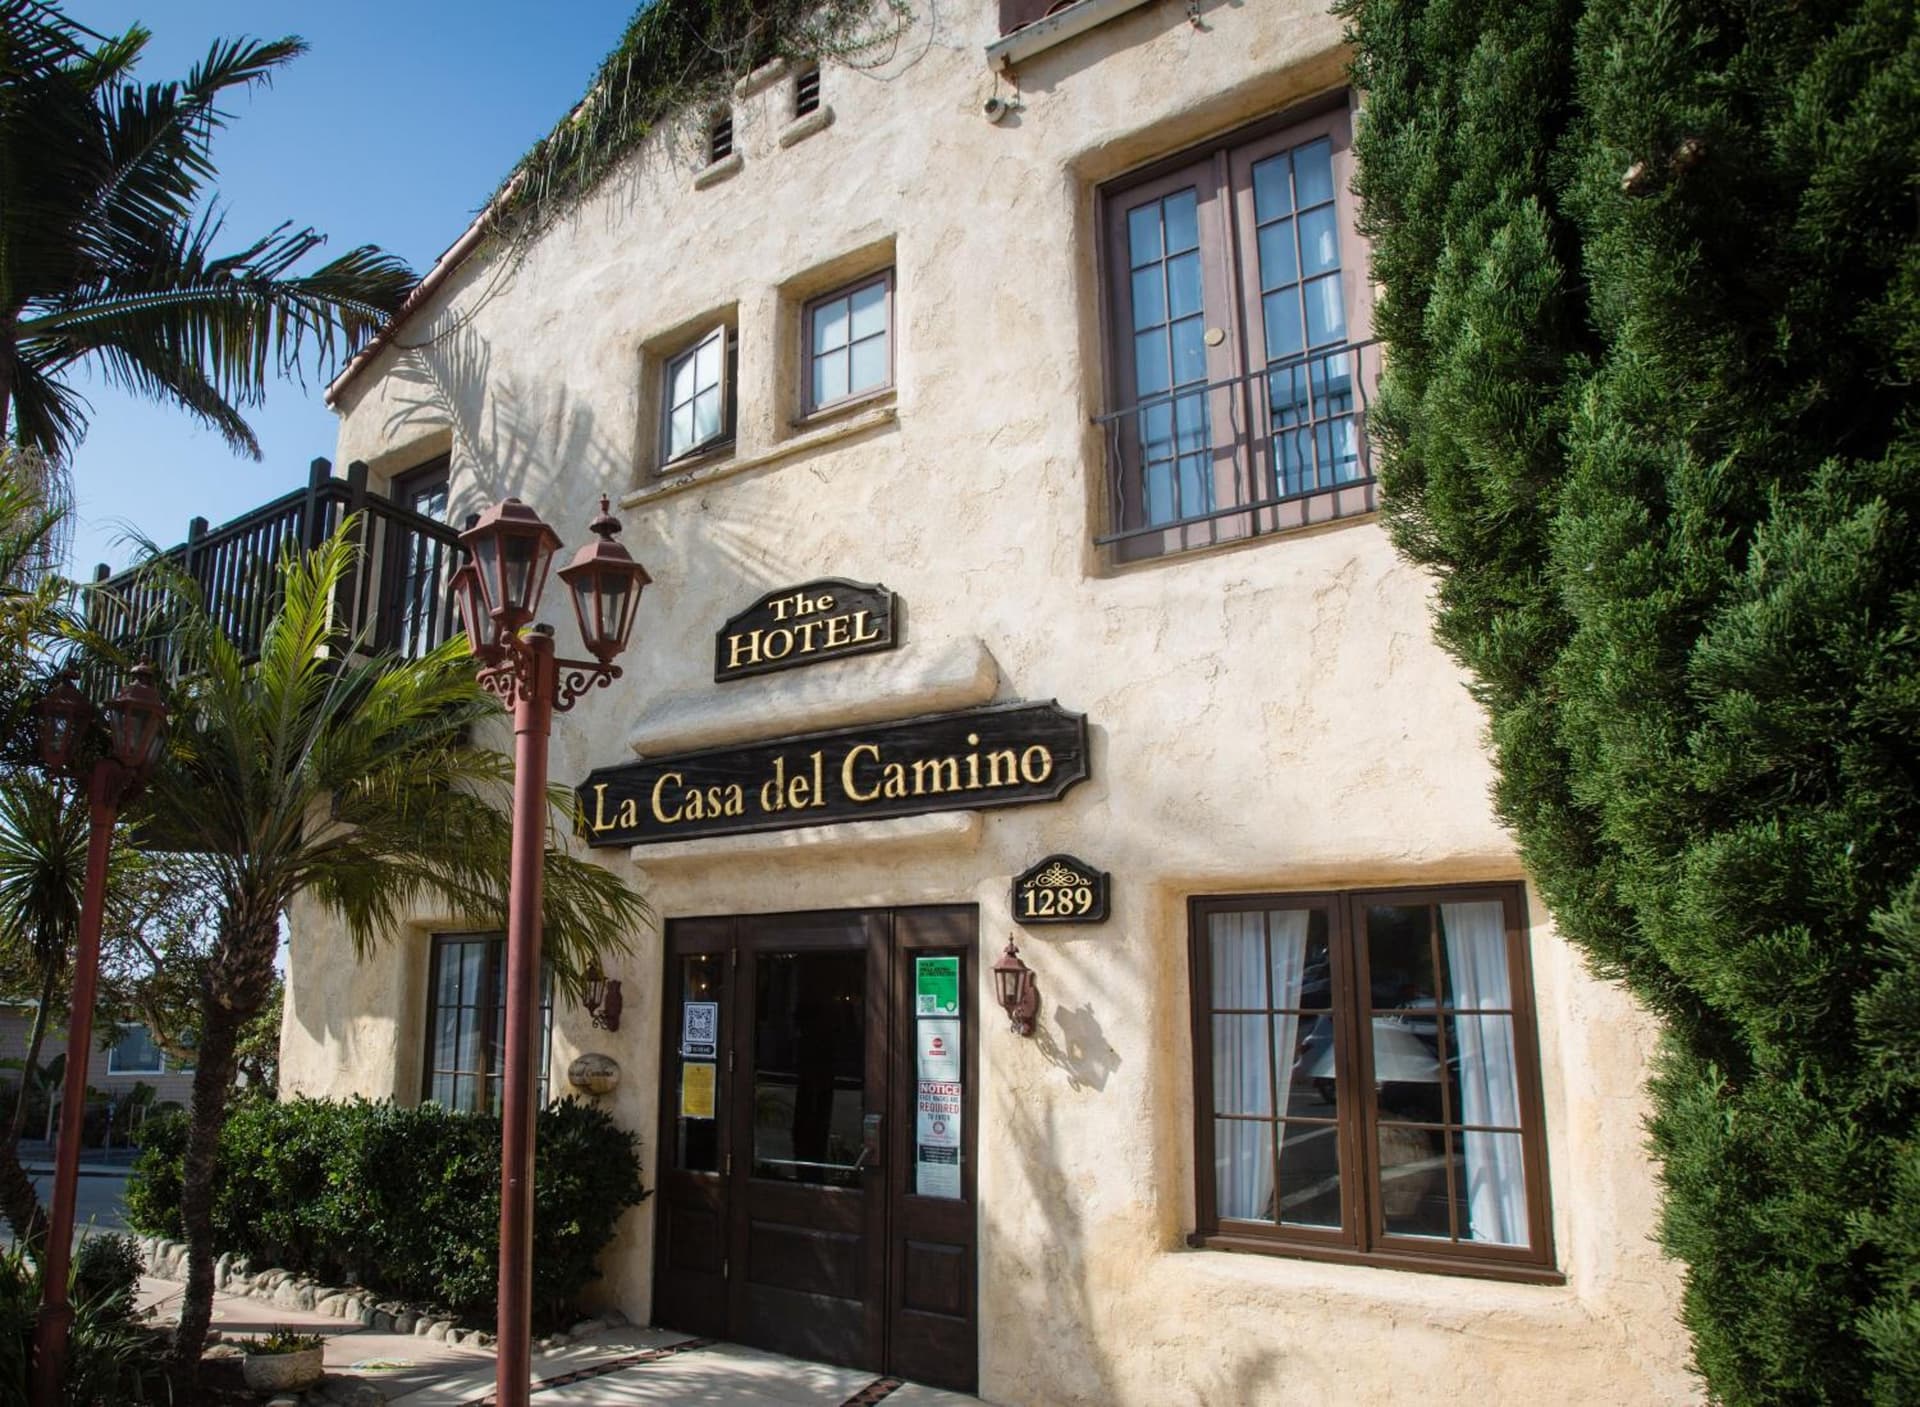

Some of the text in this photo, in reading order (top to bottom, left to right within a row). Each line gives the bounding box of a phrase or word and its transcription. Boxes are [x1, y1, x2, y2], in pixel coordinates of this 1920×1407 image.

[768, 592, 834, 622] The
[727, 610, 880, 669] HOTEL
[593, 733, 1053, 832] La Casa del Camino
[1024, 887, 1093, 916] 1289
[920, 1084, 960, 1095] NOTICE
[920, 1102, 959, 1113] REQUIRED
